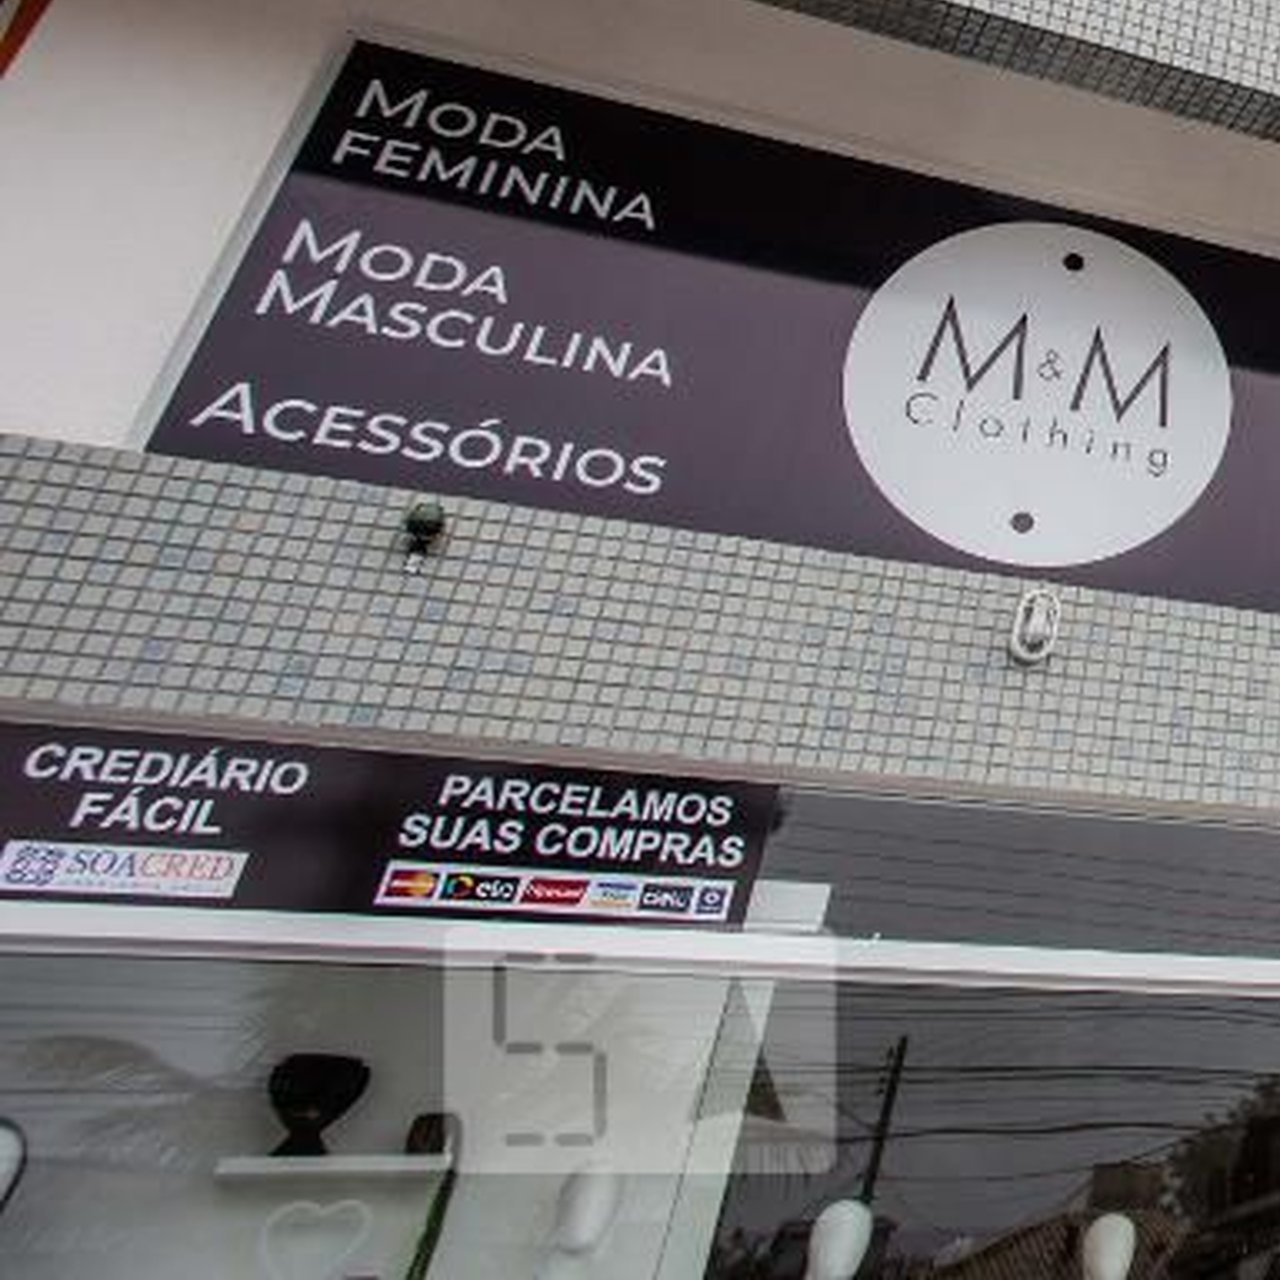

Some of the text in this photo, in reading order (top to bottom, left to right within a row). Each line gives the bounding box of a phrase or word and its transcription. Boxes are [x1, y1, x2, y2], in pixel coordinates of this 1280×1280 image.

[356, 79, 566, 161] MODA
[332, 130, 656, 230] FEMININA
[282, 219, 508, 304] MODA
[254, 269, 673, 387] MASCULINA
[189, 381, 667, 495] ACESSÓRIOS
[23, 741, 310, 795] CREDIÁRIO
[438, 774, 735, 827] PARCELAMOS
[68, 786, 222, 835] FÁCIL
[399, 812, 746, 868] SUAS COMPRAS
[66, 849, 235, 881] SOACRED
